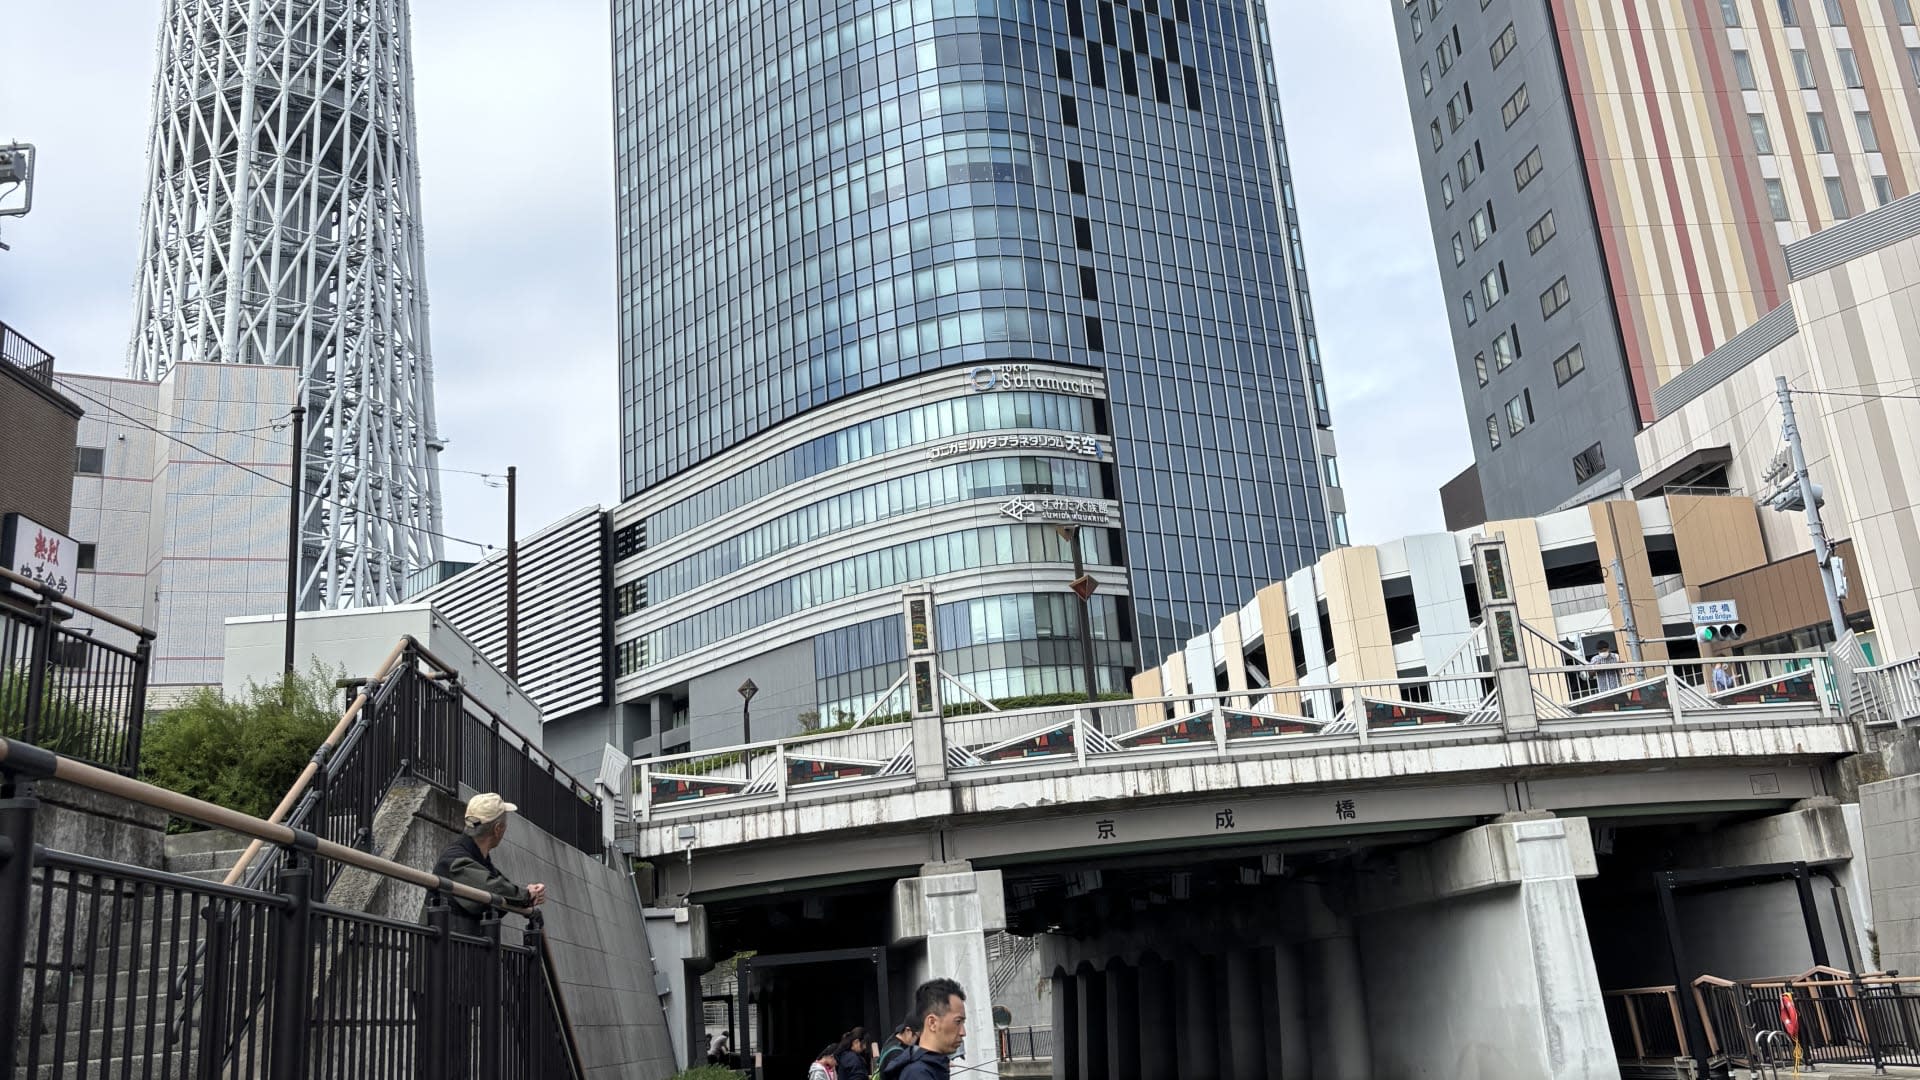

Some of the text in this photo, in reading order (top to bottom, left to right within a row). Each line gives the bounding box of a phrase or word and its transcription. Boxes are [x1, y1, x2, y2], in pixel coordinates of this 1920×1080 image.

[1002, 372, 1096, 395] Solamachi
[1041, 511, 1110, 523] SUMIDA AQUARIUM
[1697, 603, 1730, 615] 京成橋
[1096, 799, 1356, 840] 京成橋
